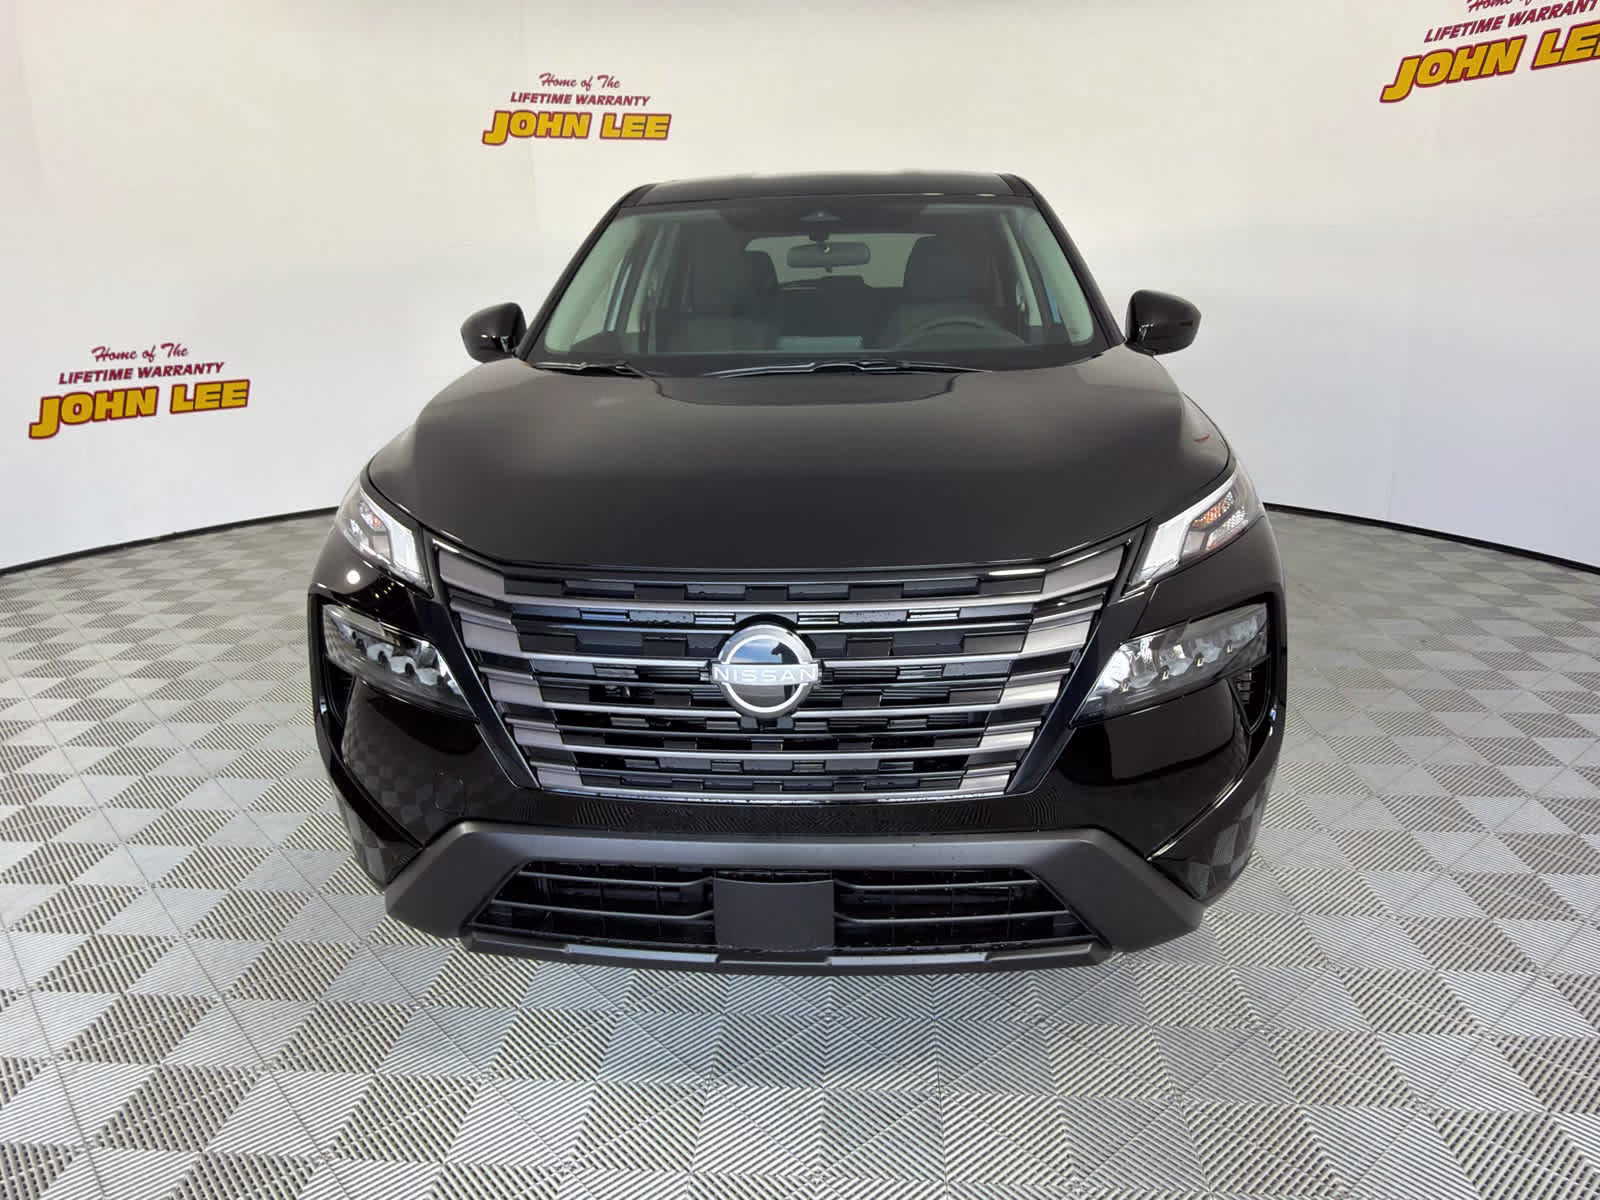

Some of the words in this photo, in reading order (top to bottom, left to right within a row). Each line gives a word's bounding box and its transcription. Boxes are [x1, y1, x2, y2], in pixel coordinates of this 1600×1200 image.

[1423, 16, 1506, 43] LIFETIME
[1379, 34, 1528, 103] JOHN
[539, 72, 577, 88] Home
[580, 75, 593, 91] of
[597, 74, 620, 89] The
[510, 92, 572, 105] LIFETIME
[575, 94, 651, 107] WARRANTY
[482, 110, 593, 146] JOHN
[599, 112, 672, 141] LEE
[91, 346, 138, 362] Home
[142, 346, 156, 363] of
[160, 343, 189, 358] The
[58, 367, 134, 385] LIFETIME
[137, 362, 225, 379] WARRANTY
[28, 385, 159, 440] JOHN
[169, 379, 251, 414] LEE
[713, 666, 816, 682] NISSAN
